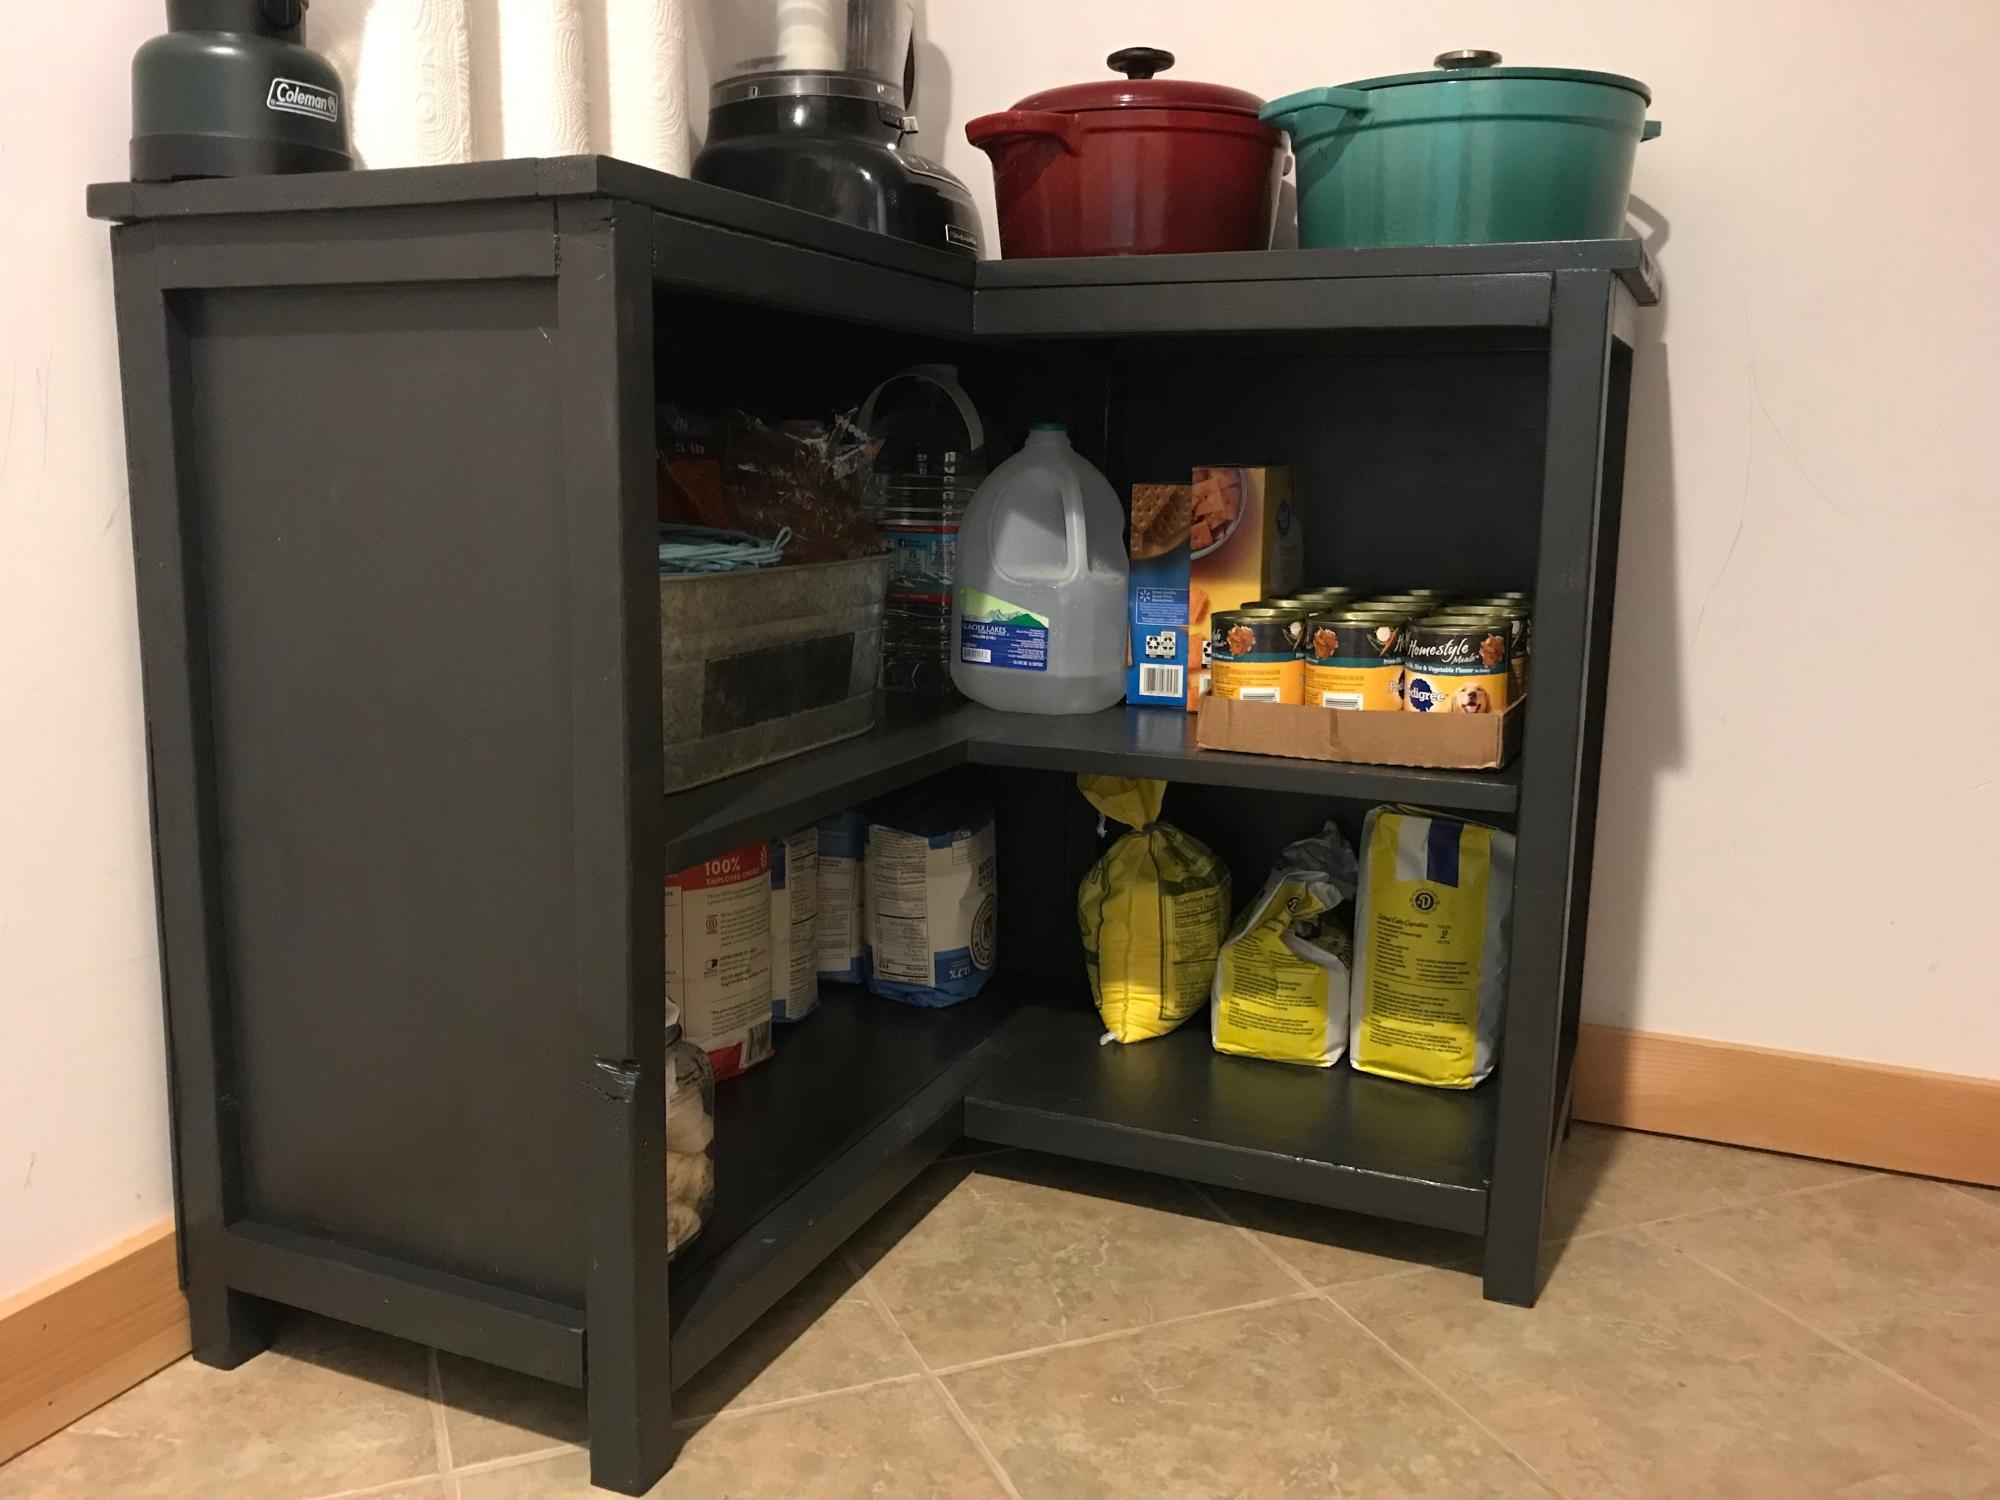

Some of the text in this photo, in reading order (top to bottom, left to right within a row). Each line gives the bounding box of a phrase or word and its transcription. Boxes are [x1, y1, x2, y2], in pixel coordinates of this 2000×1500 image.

[277, 83, 327, 110] Coleman
[987, 625, 1007, 633] LAKES
[1407, 638, 1470, 663] Homestyle
[1451, 654, 1475, 665] Meals
[1428, 665, 1454, 674] Vegetable
[704, 857, 741, 876] 100%
